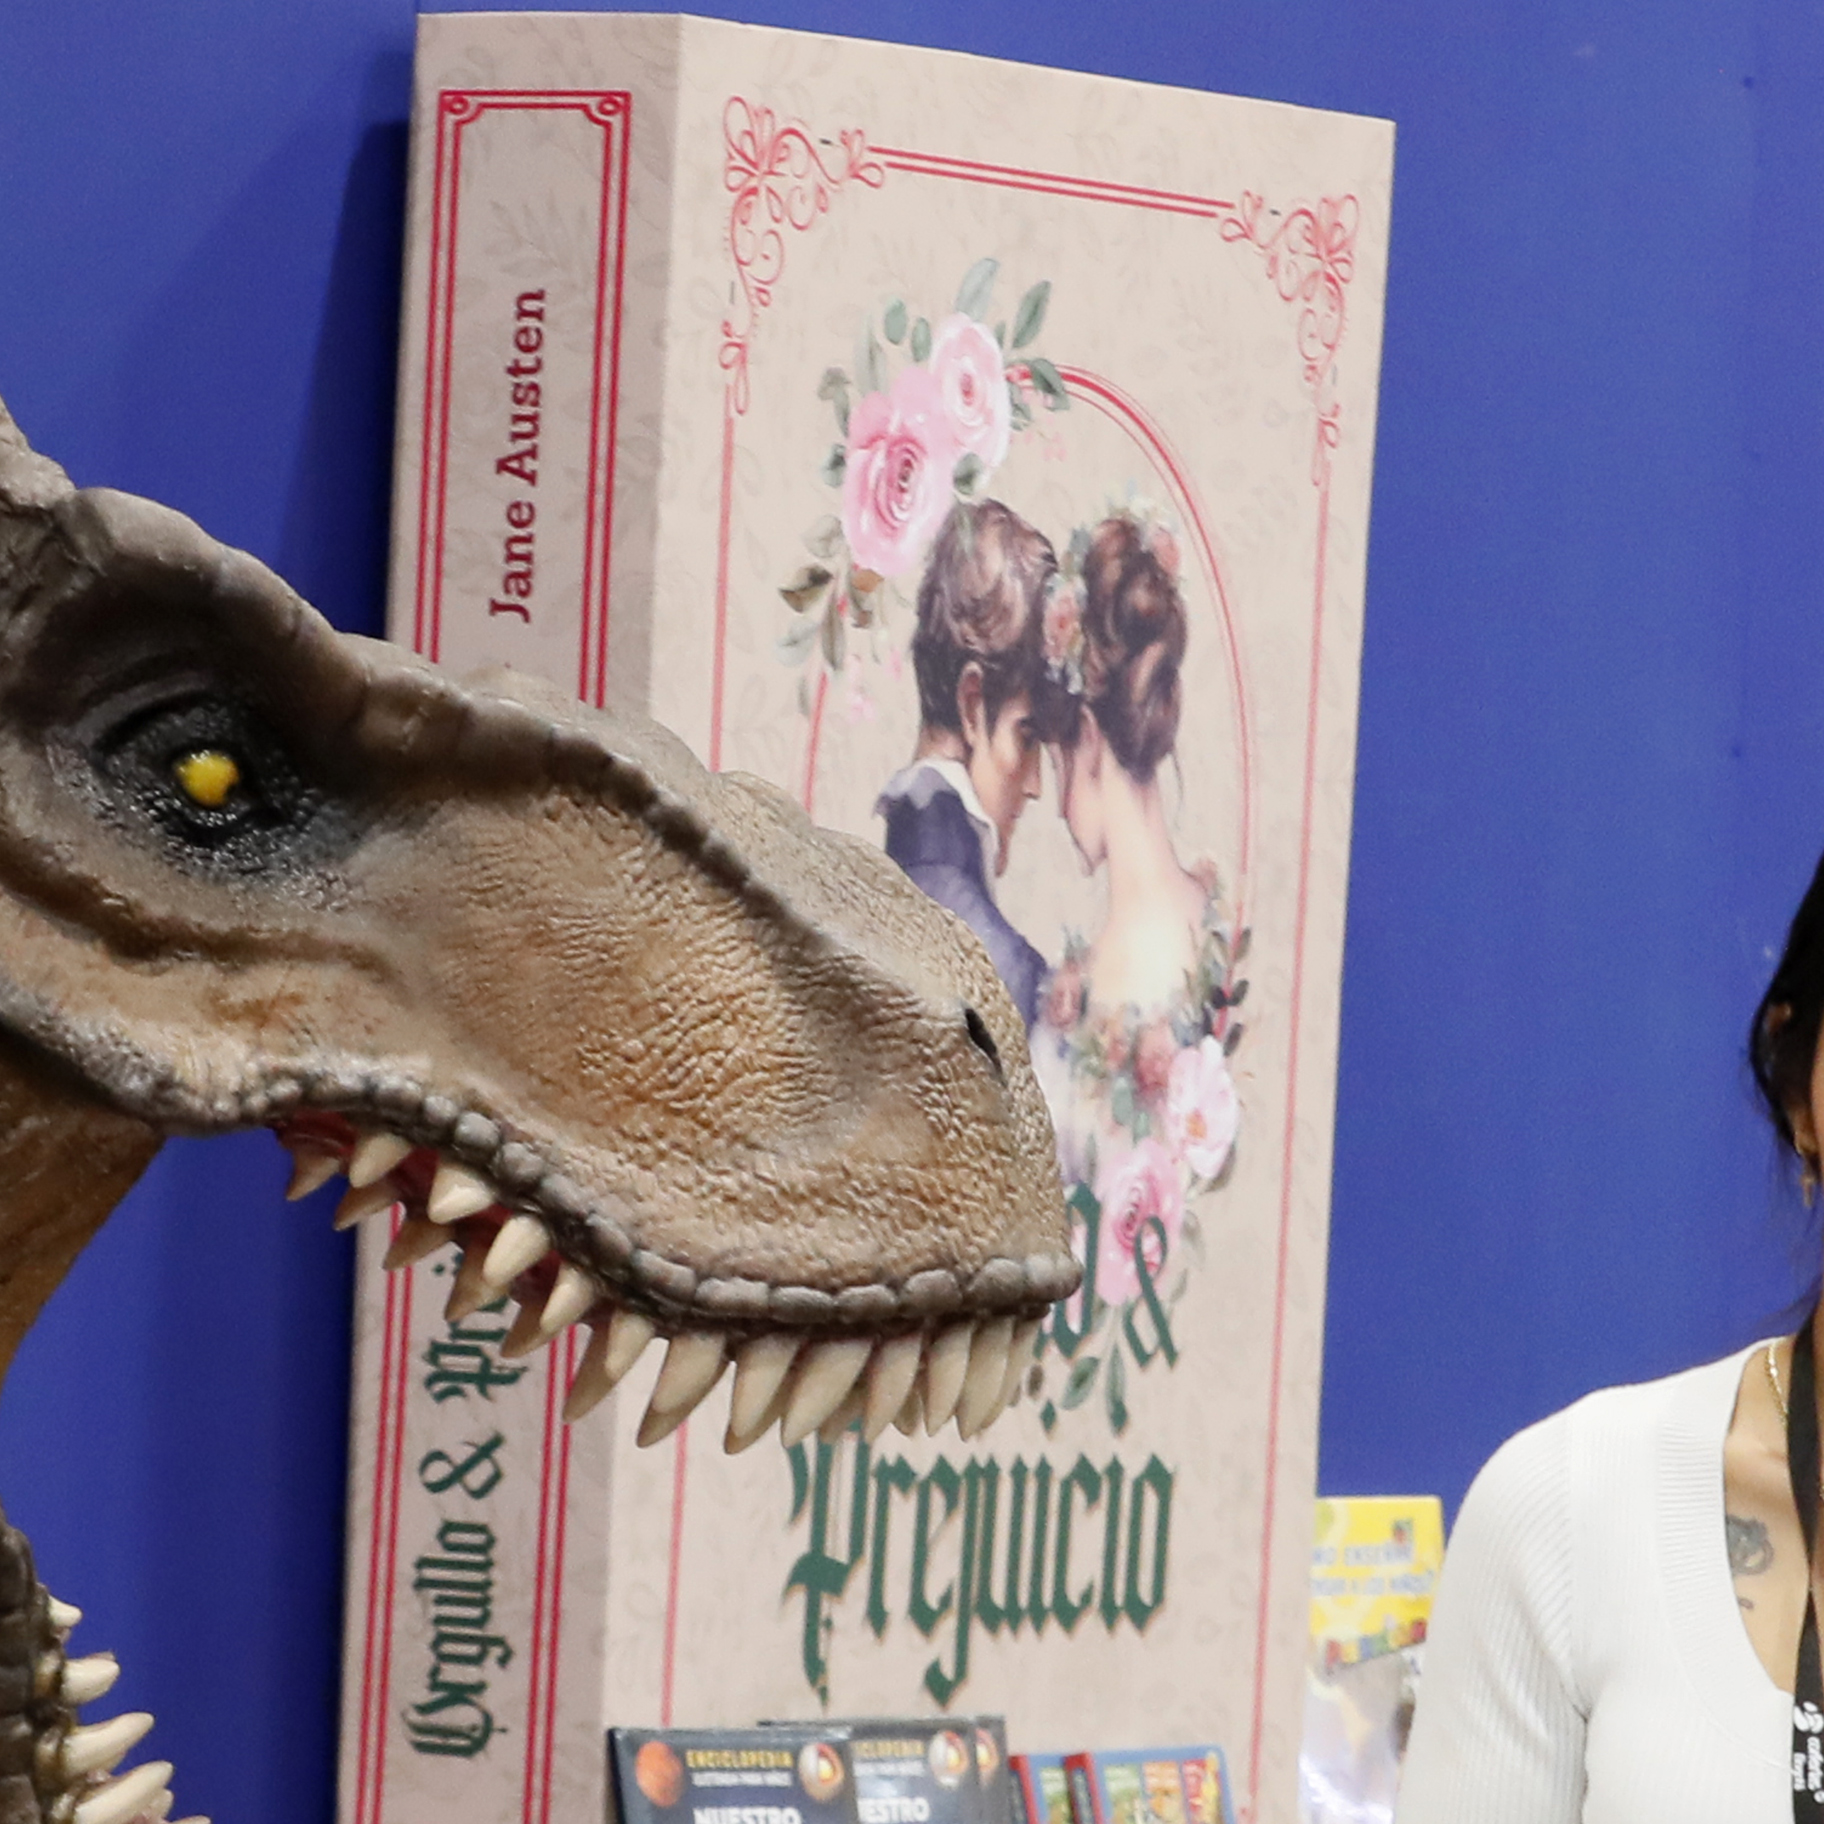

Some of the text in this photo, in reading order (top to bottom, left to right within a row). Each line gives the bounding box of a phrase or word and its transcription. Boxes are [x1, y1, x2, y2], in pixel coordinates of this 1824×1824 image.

[490, 287, 549, 624] Jane Austen
[418, 1433, 507, 1500] &
[402, 1518, 512, 1762] Orgullo
[685, 1749, 795, 1770] ENCICLOPEDIA
